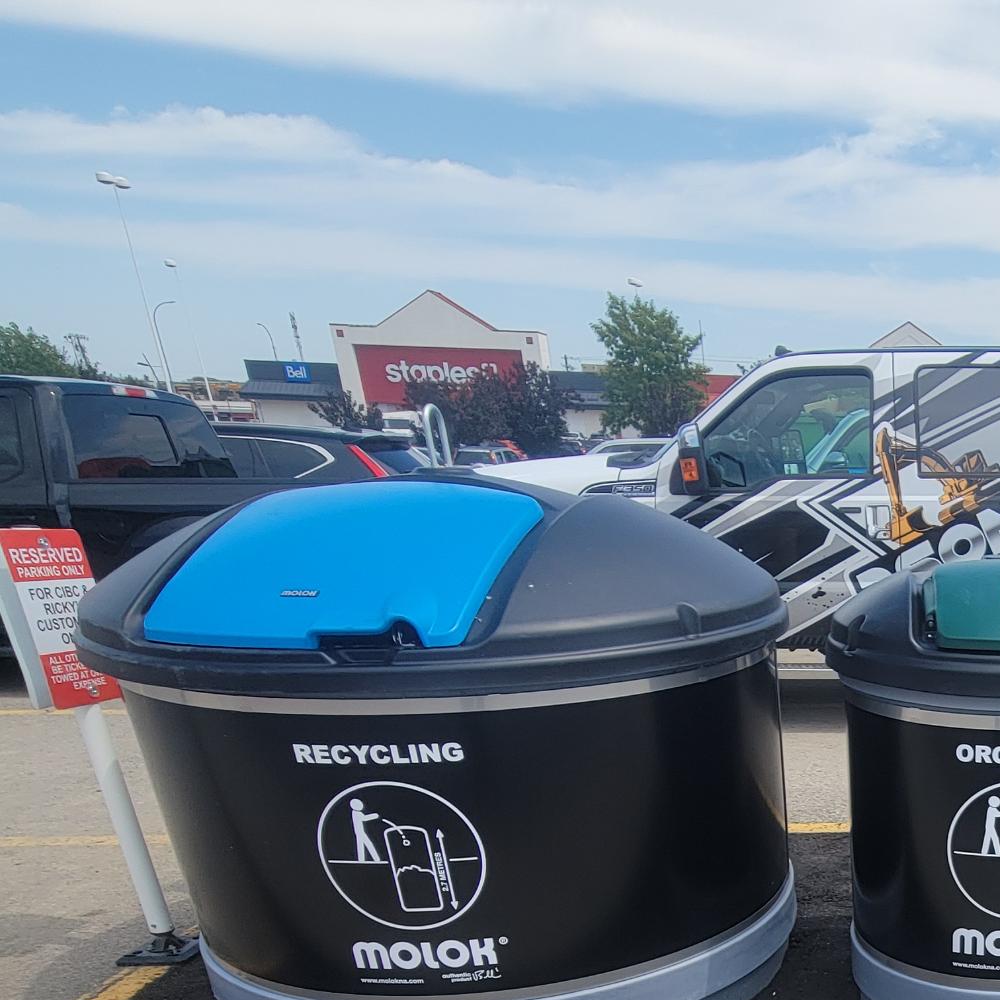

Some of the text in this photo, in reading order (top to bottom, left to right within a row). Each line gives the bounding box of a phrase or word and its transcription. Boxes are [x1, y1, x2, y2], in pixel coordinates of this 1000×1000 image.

[286, 365, 307, 379] Bell
[385, 360, 480, 384] staples
[9, 547, 83, 564] RESERVED
[17, 564, 86, 578] PARKING ONLY
[28, 587, 53, 600] FOR
[55, 585, 80, 598] CIBC
[49, 656, 65, 665] ALL
[51, 665, 63, 674] BE
[51, 672, 79, 684] TOWED
[80, 670, 89, 679] AT
[292, 742, 465, 764] RECYCLING
[434, 852, 447, 880] METRES
